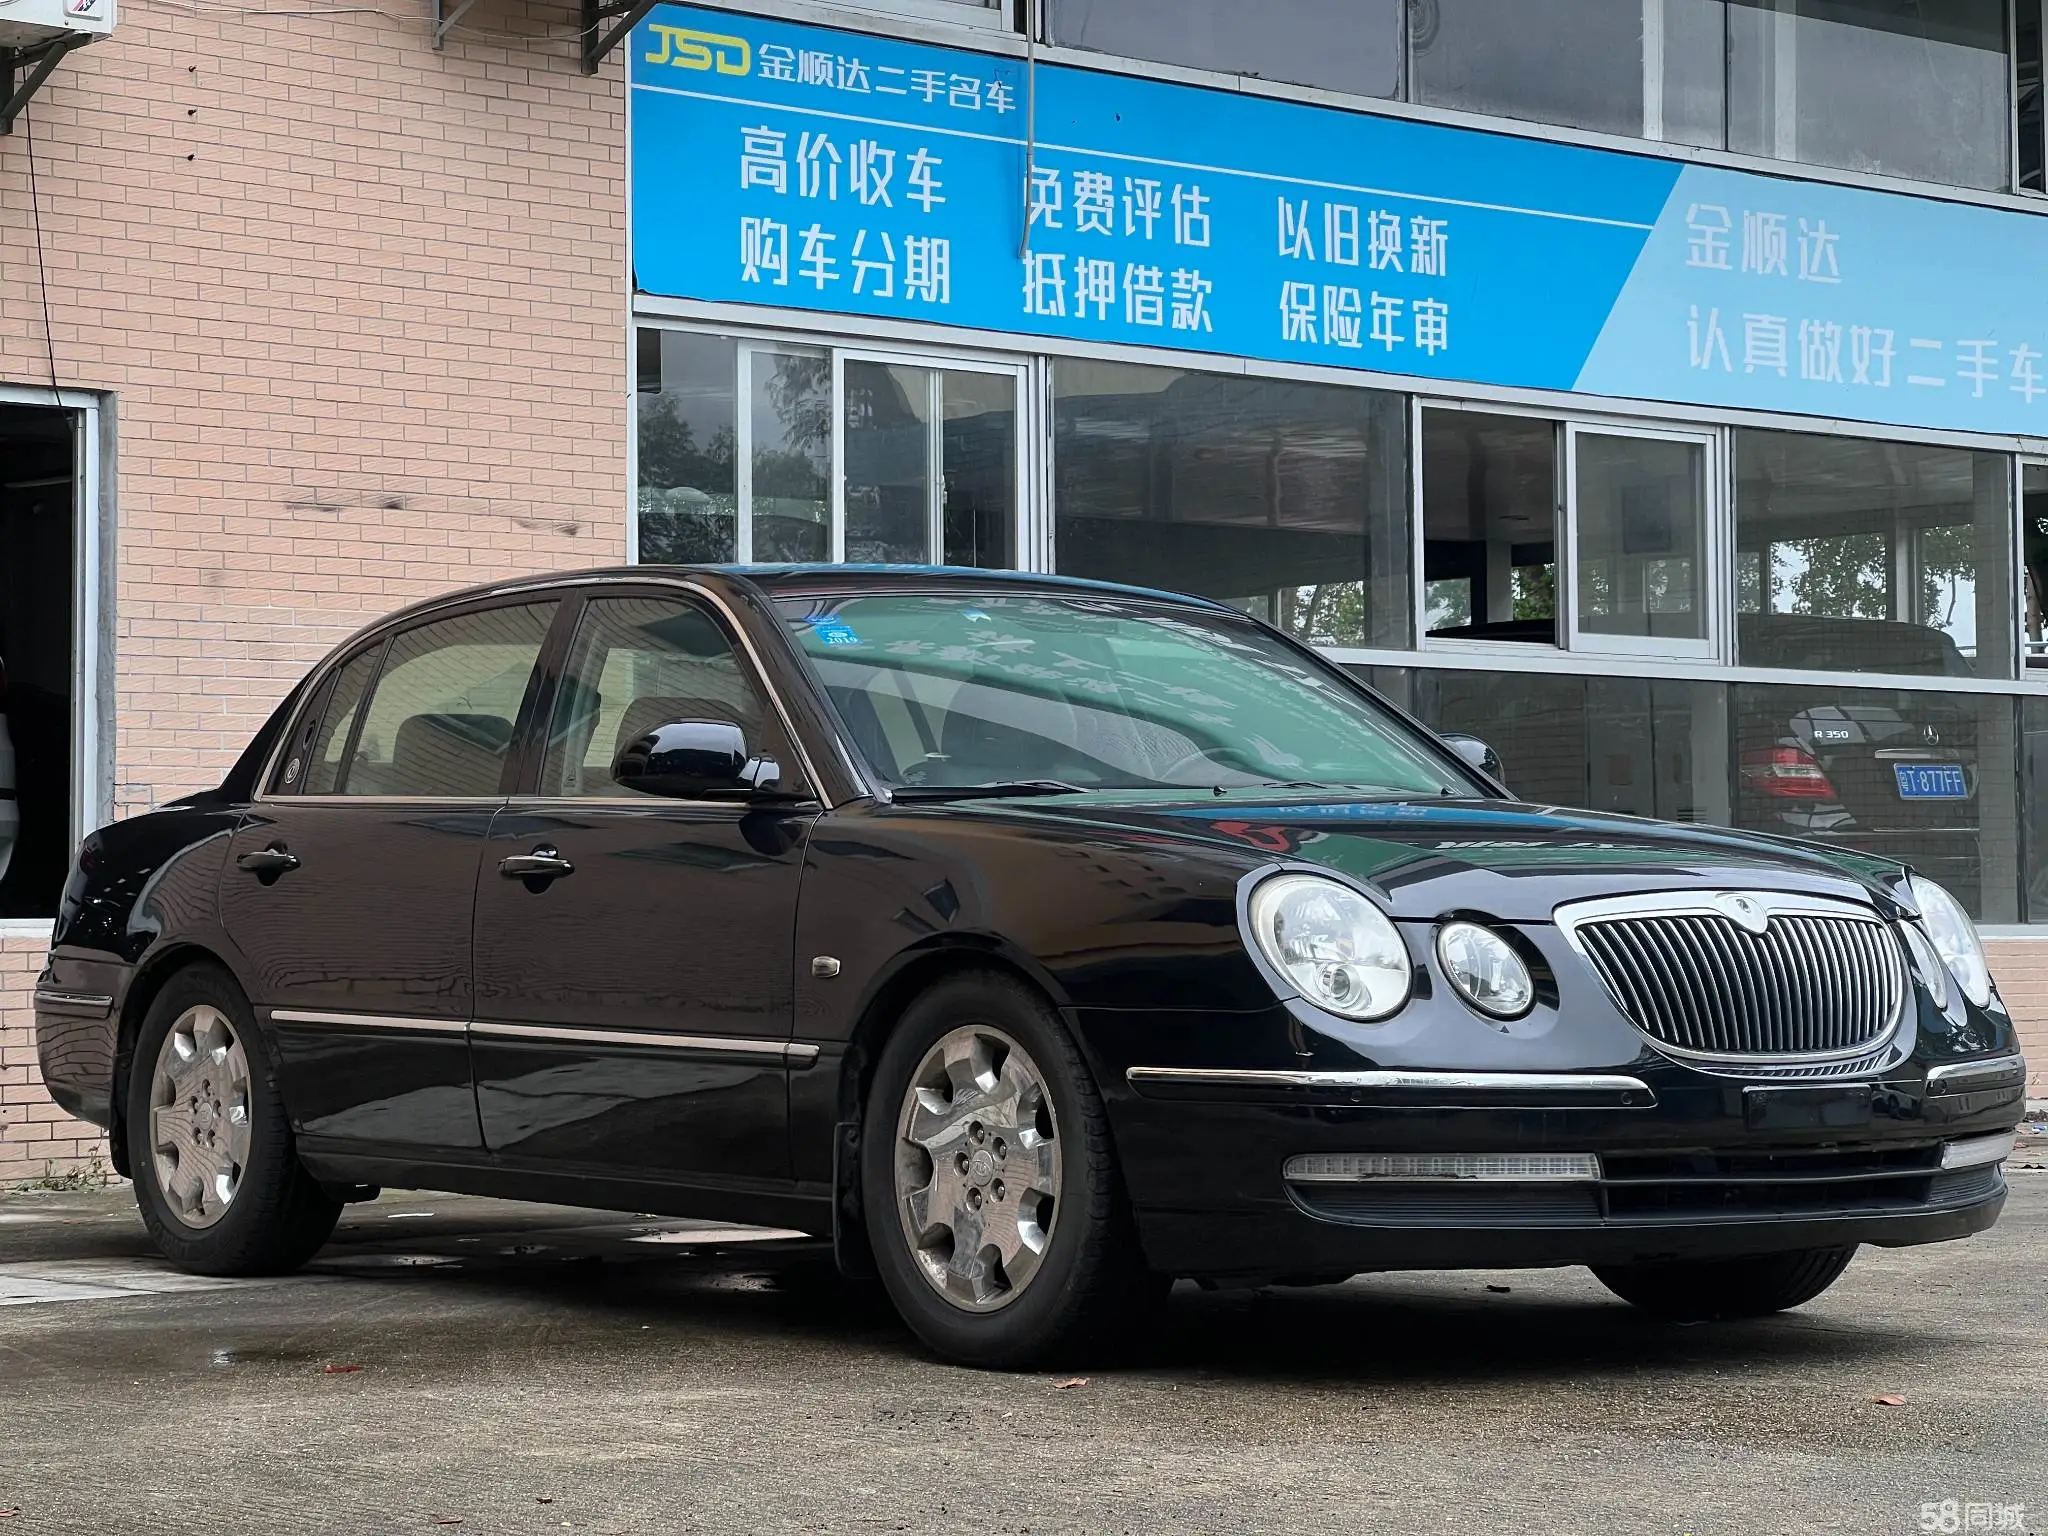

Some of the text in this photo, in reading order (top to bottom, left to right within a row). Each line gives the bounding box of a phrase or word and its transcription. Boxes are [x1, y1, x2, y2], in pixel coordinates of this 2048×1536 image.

[645, 23, 750, 76] JSD
[757, 43, 1017, 114] 金顺达二手名车
[740, 126, 1448, 278] 高价收车 免费评估 以旧换新
[1685, 204, 1843, 285] 金顺达
[740, 216, 1448, 357] 购车分期 抵押借款 保险年审
[1688, 305, 2047, 403] 认真做好二手车
[1814, 730, 1849, 739] R 350
